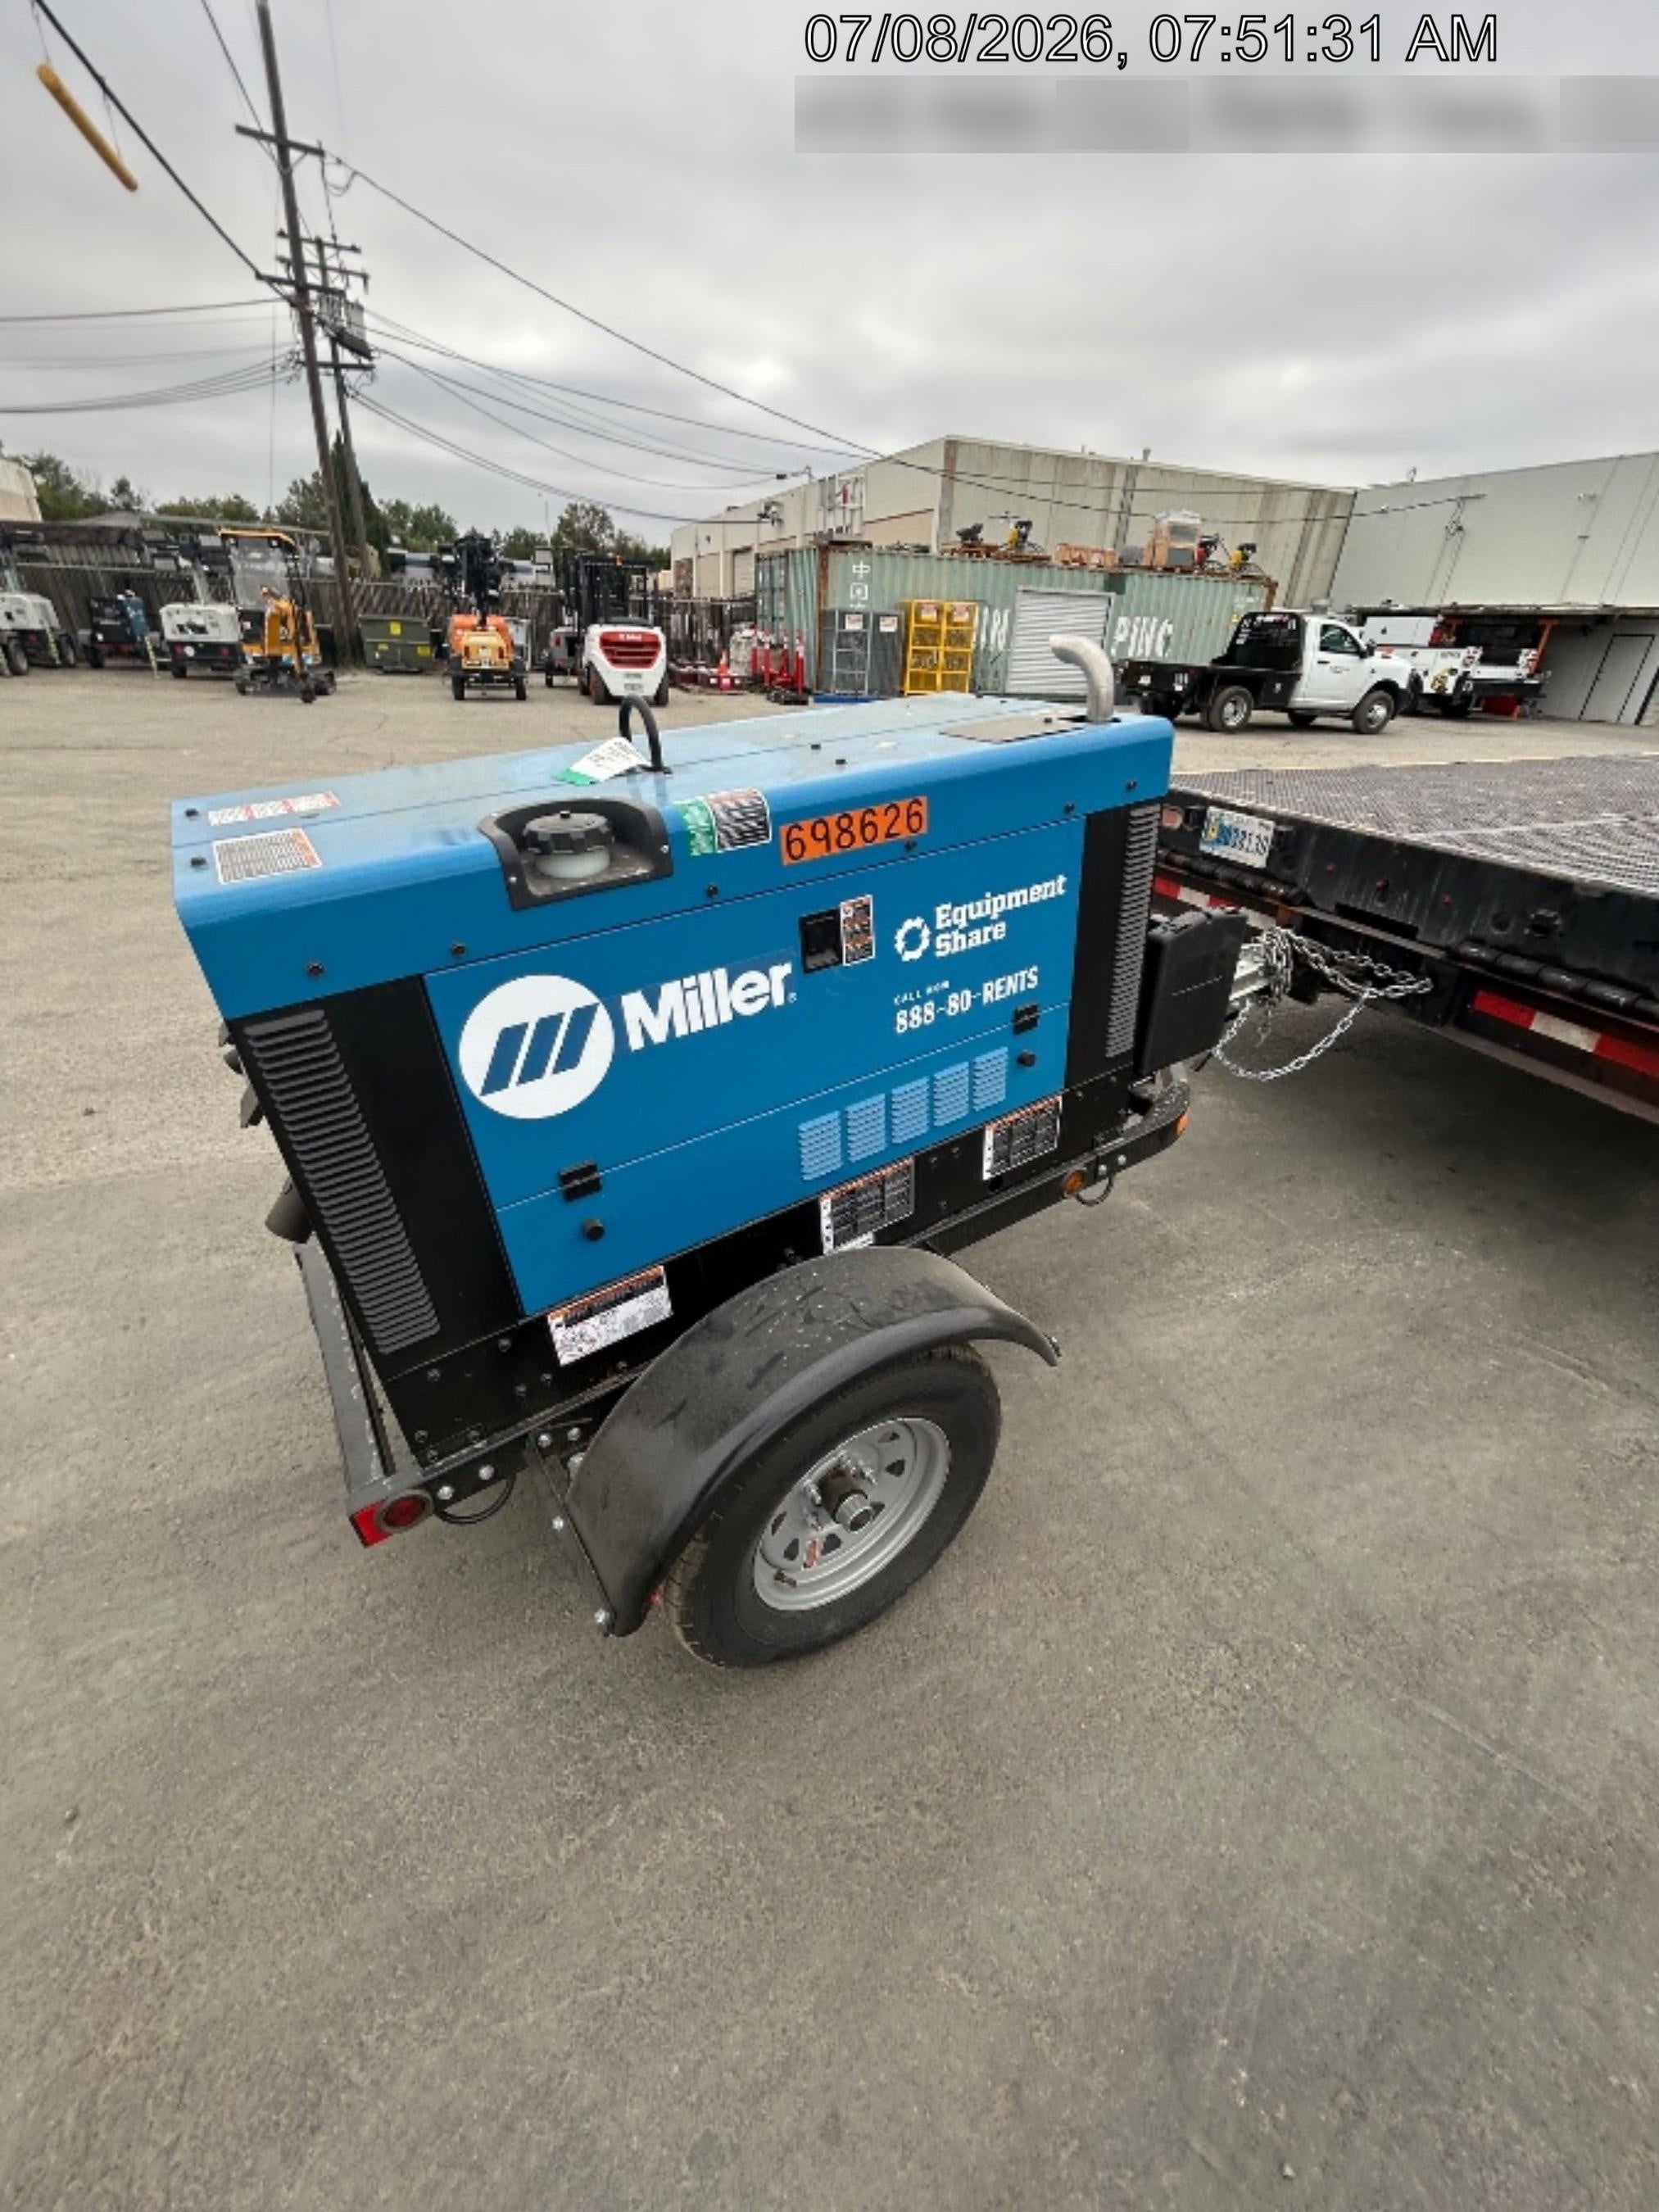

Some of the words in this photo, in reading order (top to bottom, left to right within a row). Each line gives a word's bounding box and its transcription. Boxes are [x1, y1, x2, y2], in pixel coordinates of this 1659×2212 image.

[785, 797, 924, 861] 698626
[935, 874, 1067, 930] Equipment
[935, 921, 1007, 958] Share
[620, 962, 791, 1053] Miller
[894, 989, 922, 1005] CALL
[895, 965, 1039, 1034] 888-80-RENTS
